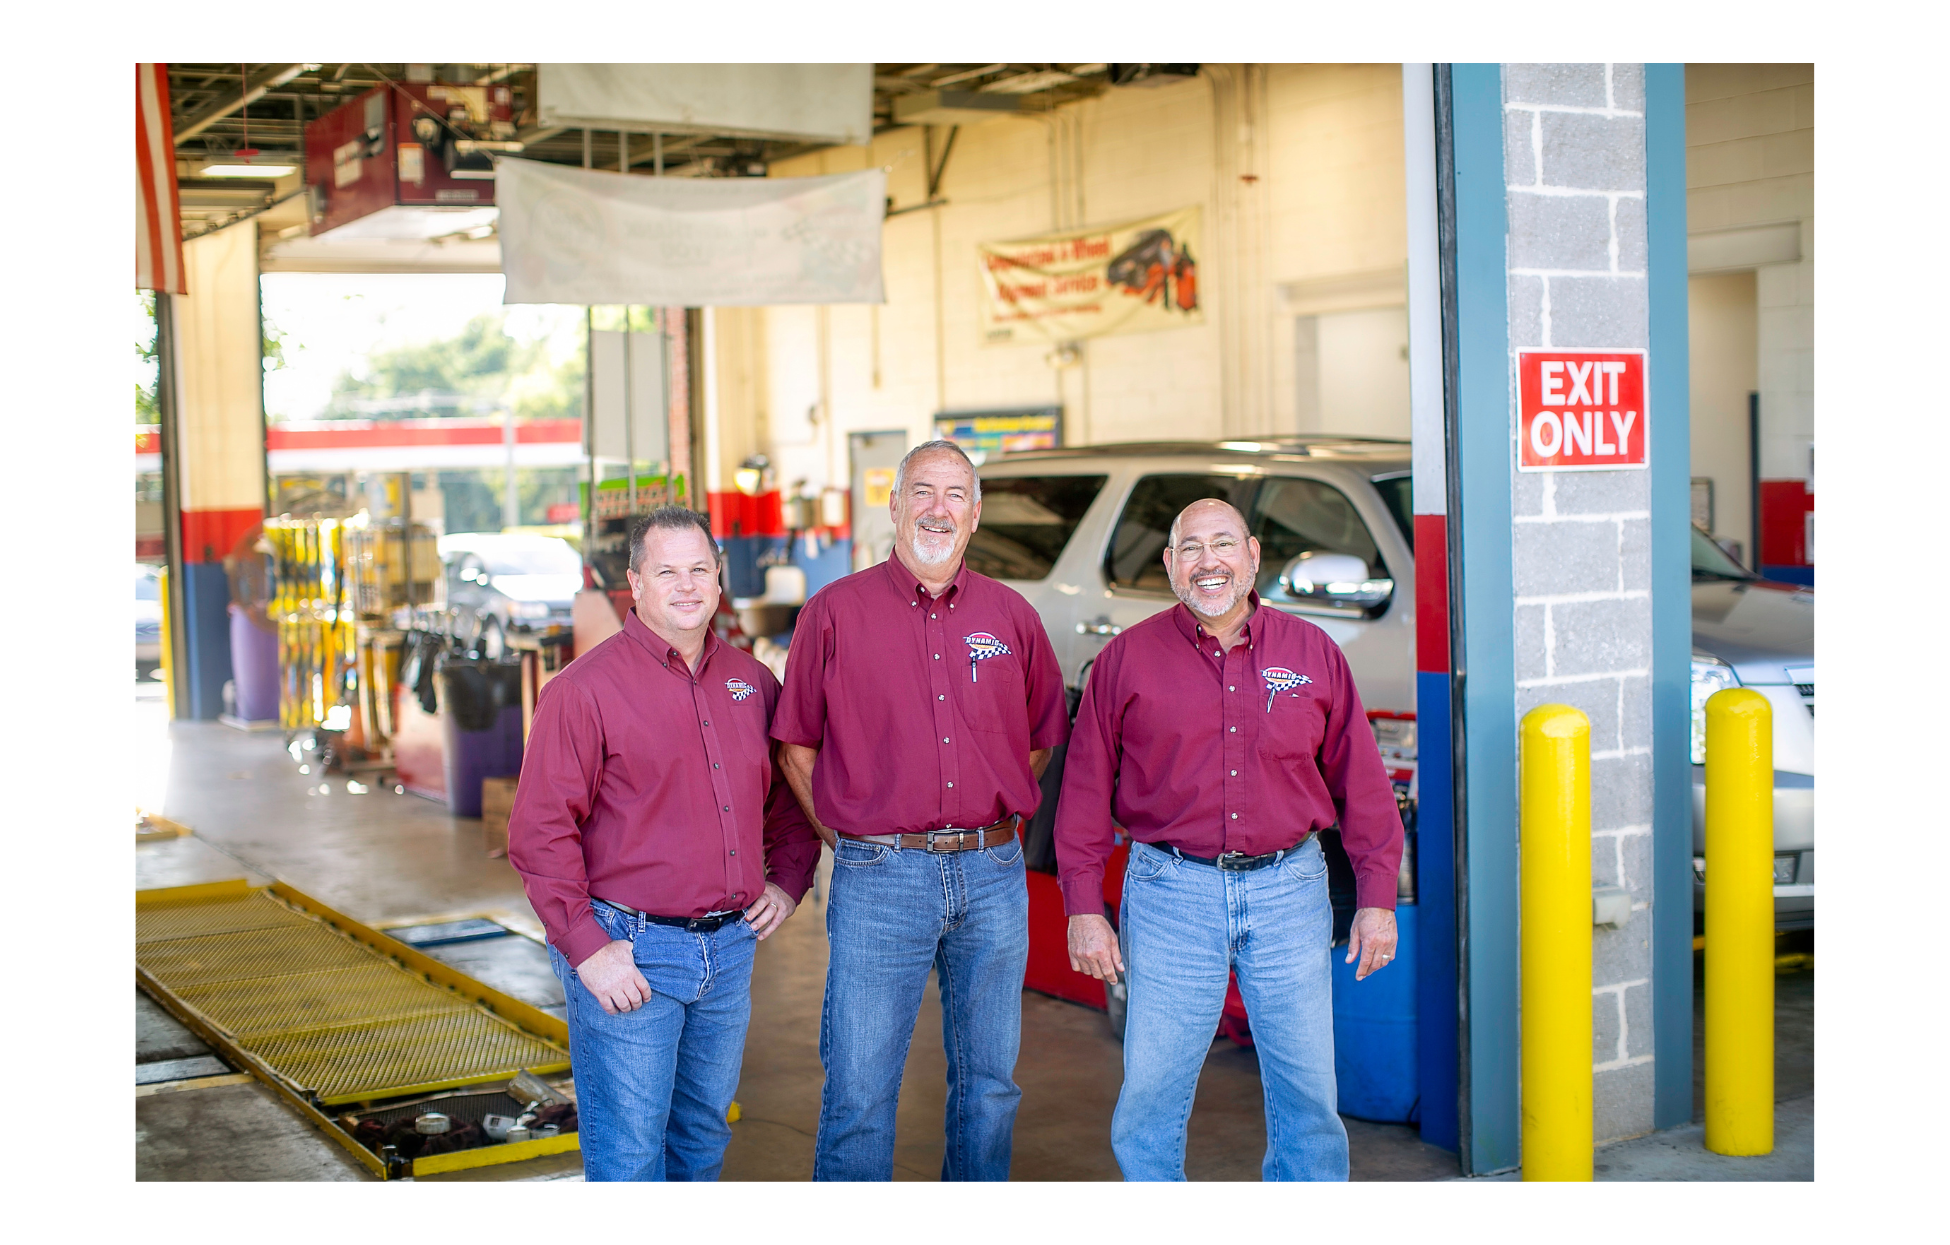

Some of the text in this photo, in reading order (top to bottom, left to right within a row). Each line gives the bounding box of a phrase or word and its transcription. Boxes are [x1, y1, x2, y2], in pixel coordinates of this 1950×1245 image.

[1541, 361, 1626, 406] EXIT
[1530, 411, 1637, 458] ONLY
[964, 637, 1000, 646] DYNAMIC
[1261, 670, 1297, 680] DYNAMIC
